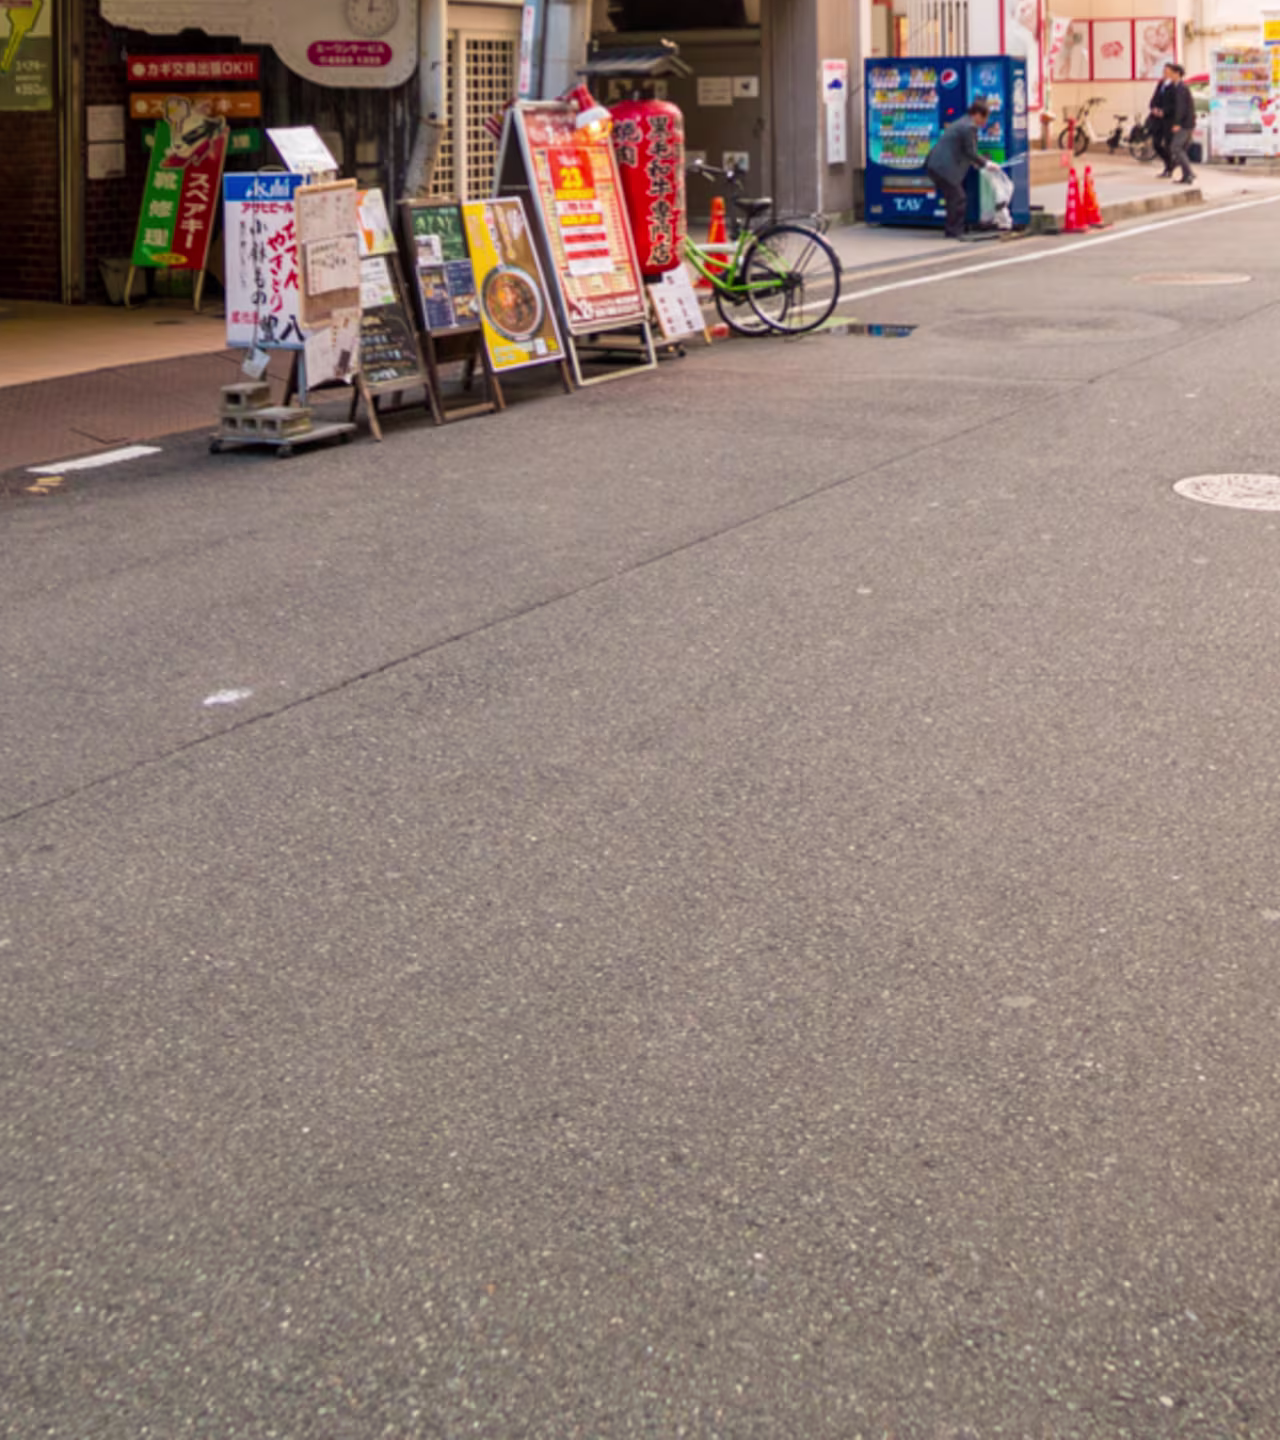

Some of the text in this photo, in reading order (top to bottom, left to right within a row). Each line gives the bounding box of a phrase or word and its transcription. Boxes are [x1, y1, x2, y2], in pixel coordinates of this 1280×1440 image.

[179, 172, 210, 249] スペアキー
